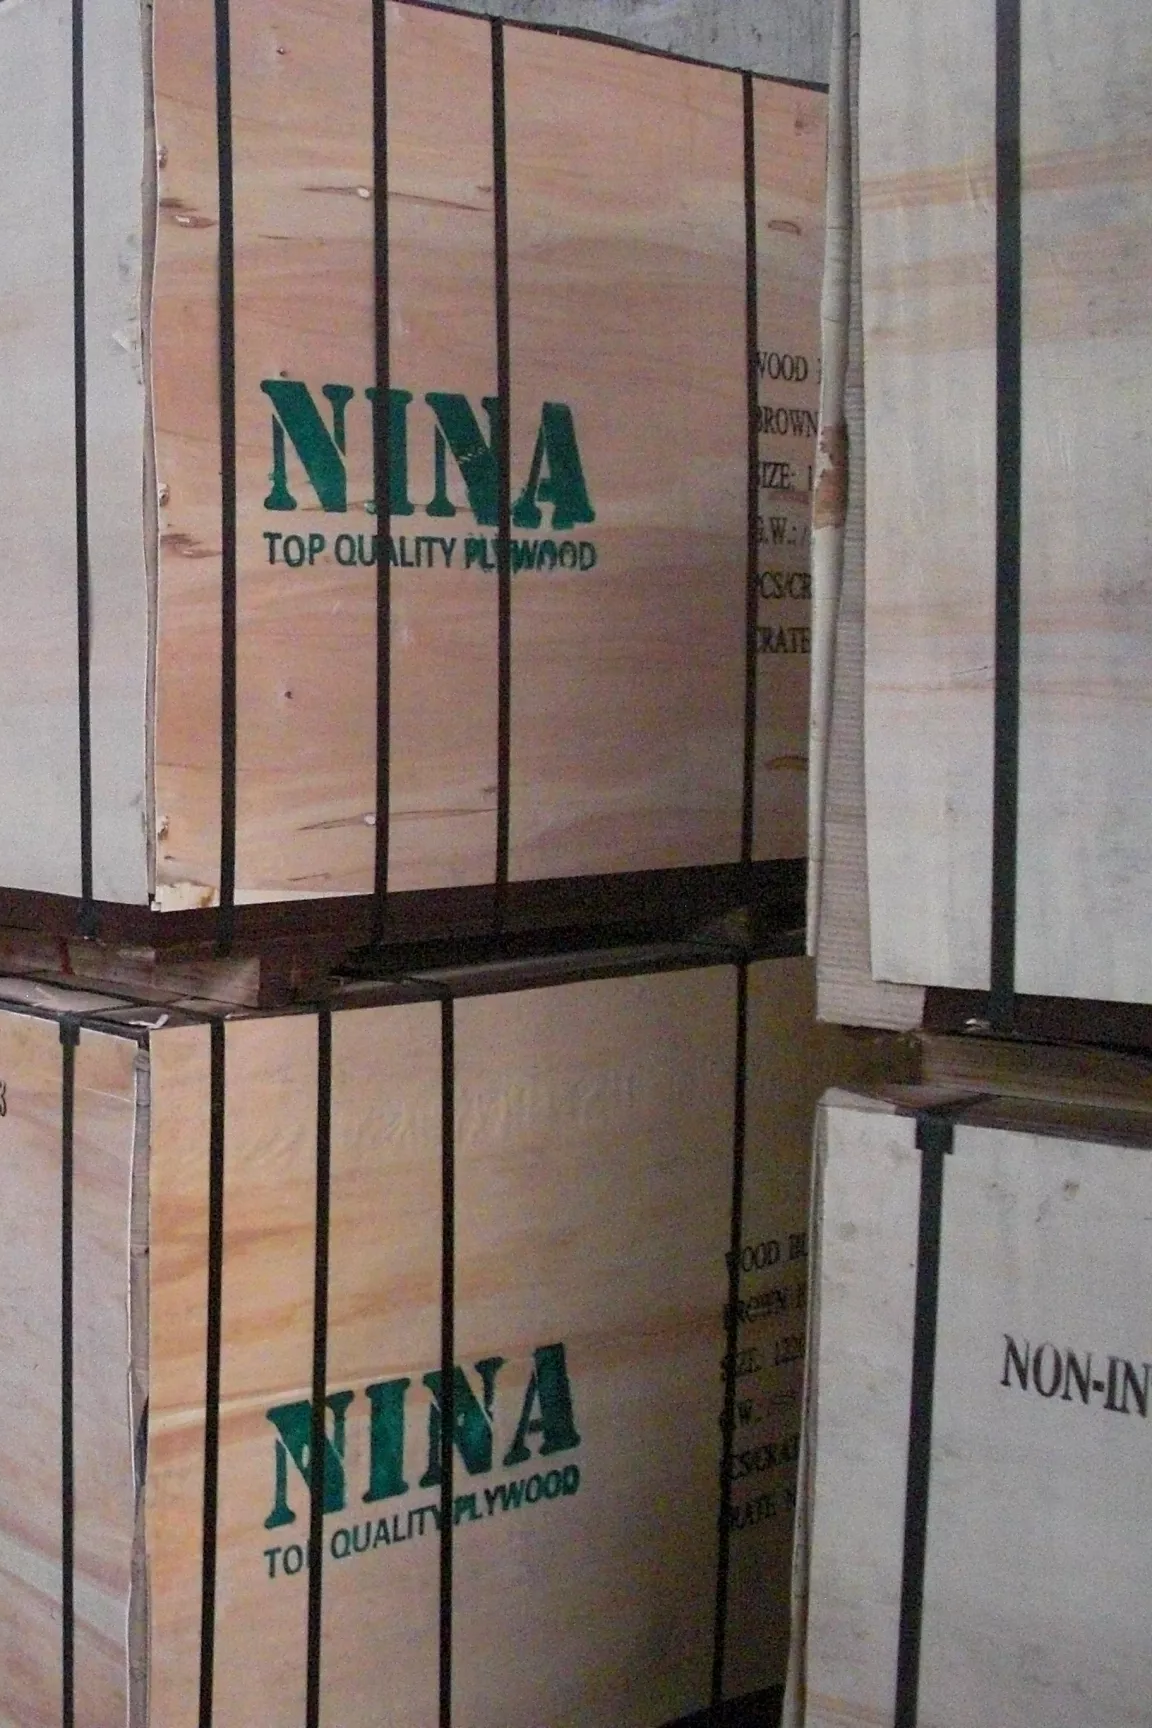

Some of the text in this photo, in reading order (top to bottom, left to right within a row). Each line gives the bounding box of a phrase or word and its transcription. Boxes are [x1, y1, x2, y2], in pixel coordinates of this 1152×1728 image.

[261, 379, 596, 530] NINA
[756, 461, 796, 492] IZE:
[263, 532, 326, 568] TOP
[725, 1239, 781, 1273] OOD
[264, 1342, 582, 1530] NINA
[330, 1504, 448, 1560] QUALITY
[452, 1464, 582, 1526] PLYWOOD
